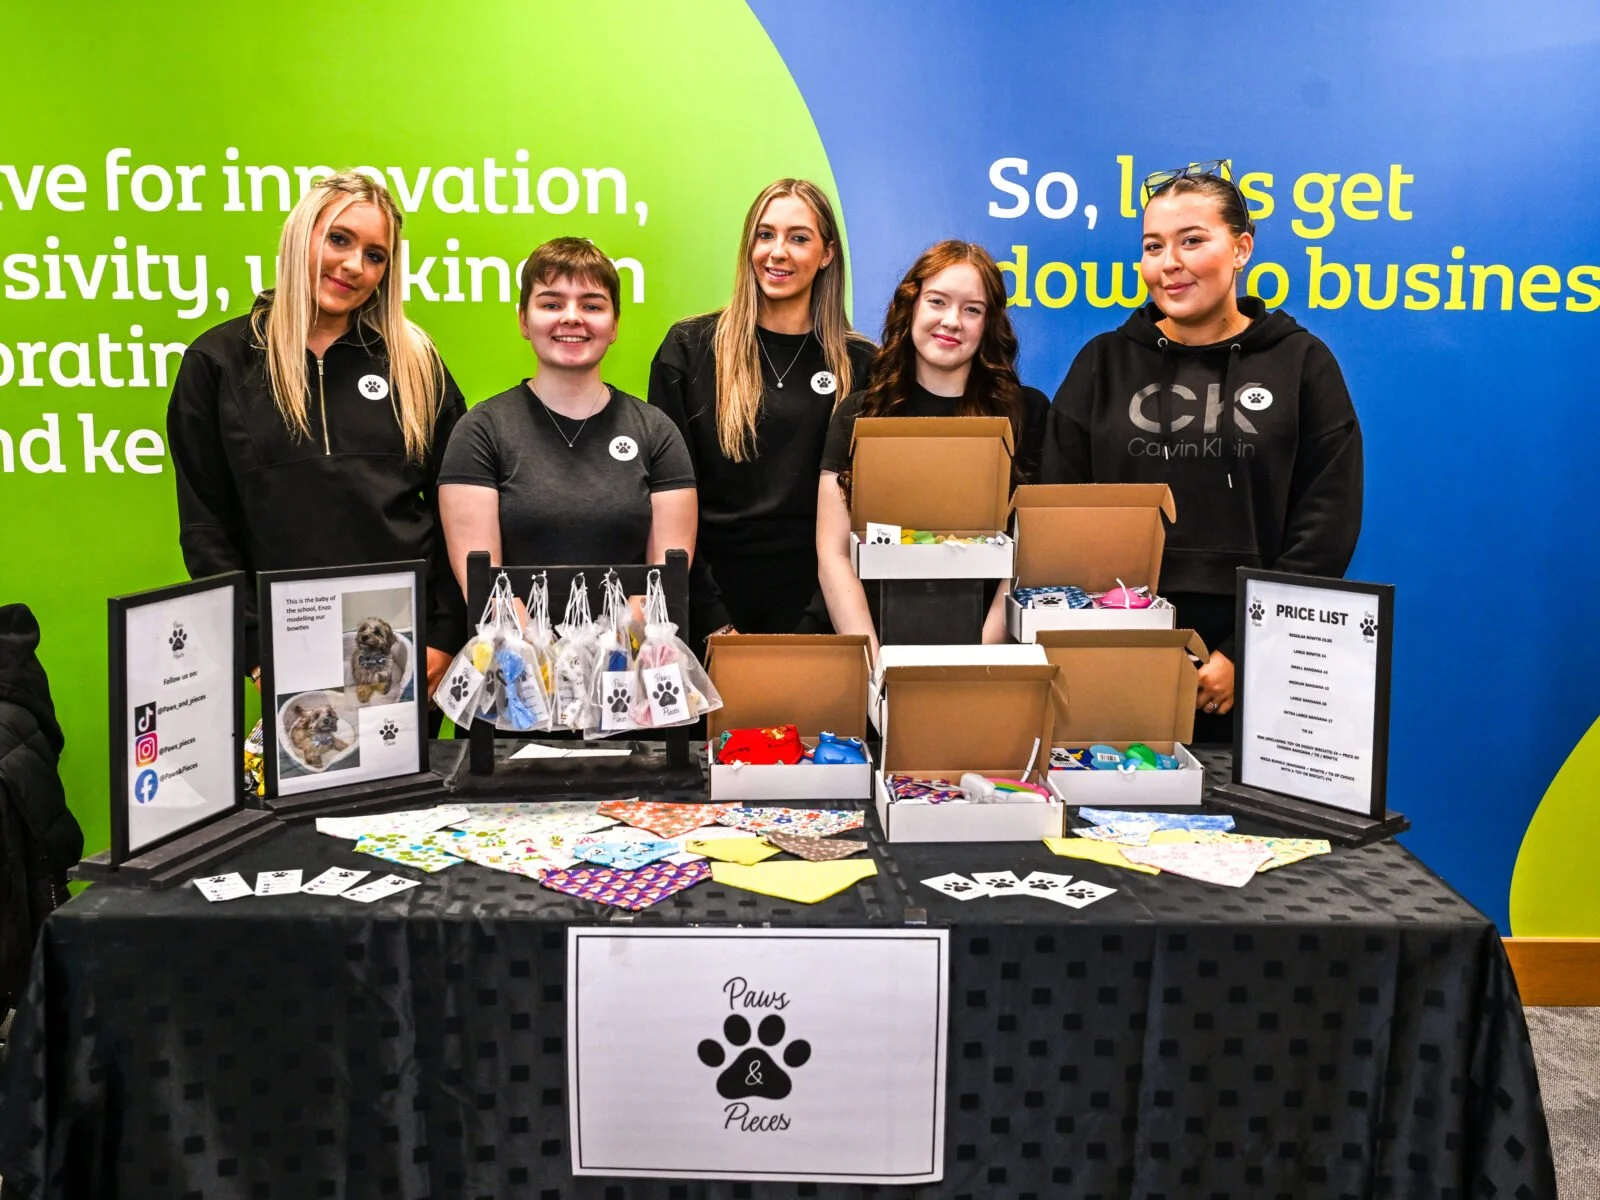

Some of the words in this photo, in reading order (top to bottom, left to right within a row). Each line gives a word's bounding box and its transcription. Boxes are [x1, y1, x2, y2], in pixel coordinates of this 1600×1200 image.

[0, 164, 87, 212] ve
[105, 147, 206, 212] for
[988, 157, 1098, 230] So,
[1291, 164, 1414, 239] get
[3, 235, 230, 320] sivity,
[996, 245, 1150, 309] dow
[1245, 262, 1290, 310] o
[0, 324, 189, 388] ratin
[1128, 382, 1264, 435] CK
[77, 412, 166, 474] ke
[1202, 436, 1256, 458] Klin
[304, 596, 315, 604] the
[1277, 604, 1315, 621] PRICE
[1319, 609, 1349, 626] LIST
[163, 676, 181, 686] Follow
[722, 976, 791, 1011] Paws
[744, 1059, 765, 1086] &
[724, 1102, 792, 1133] Pieces
